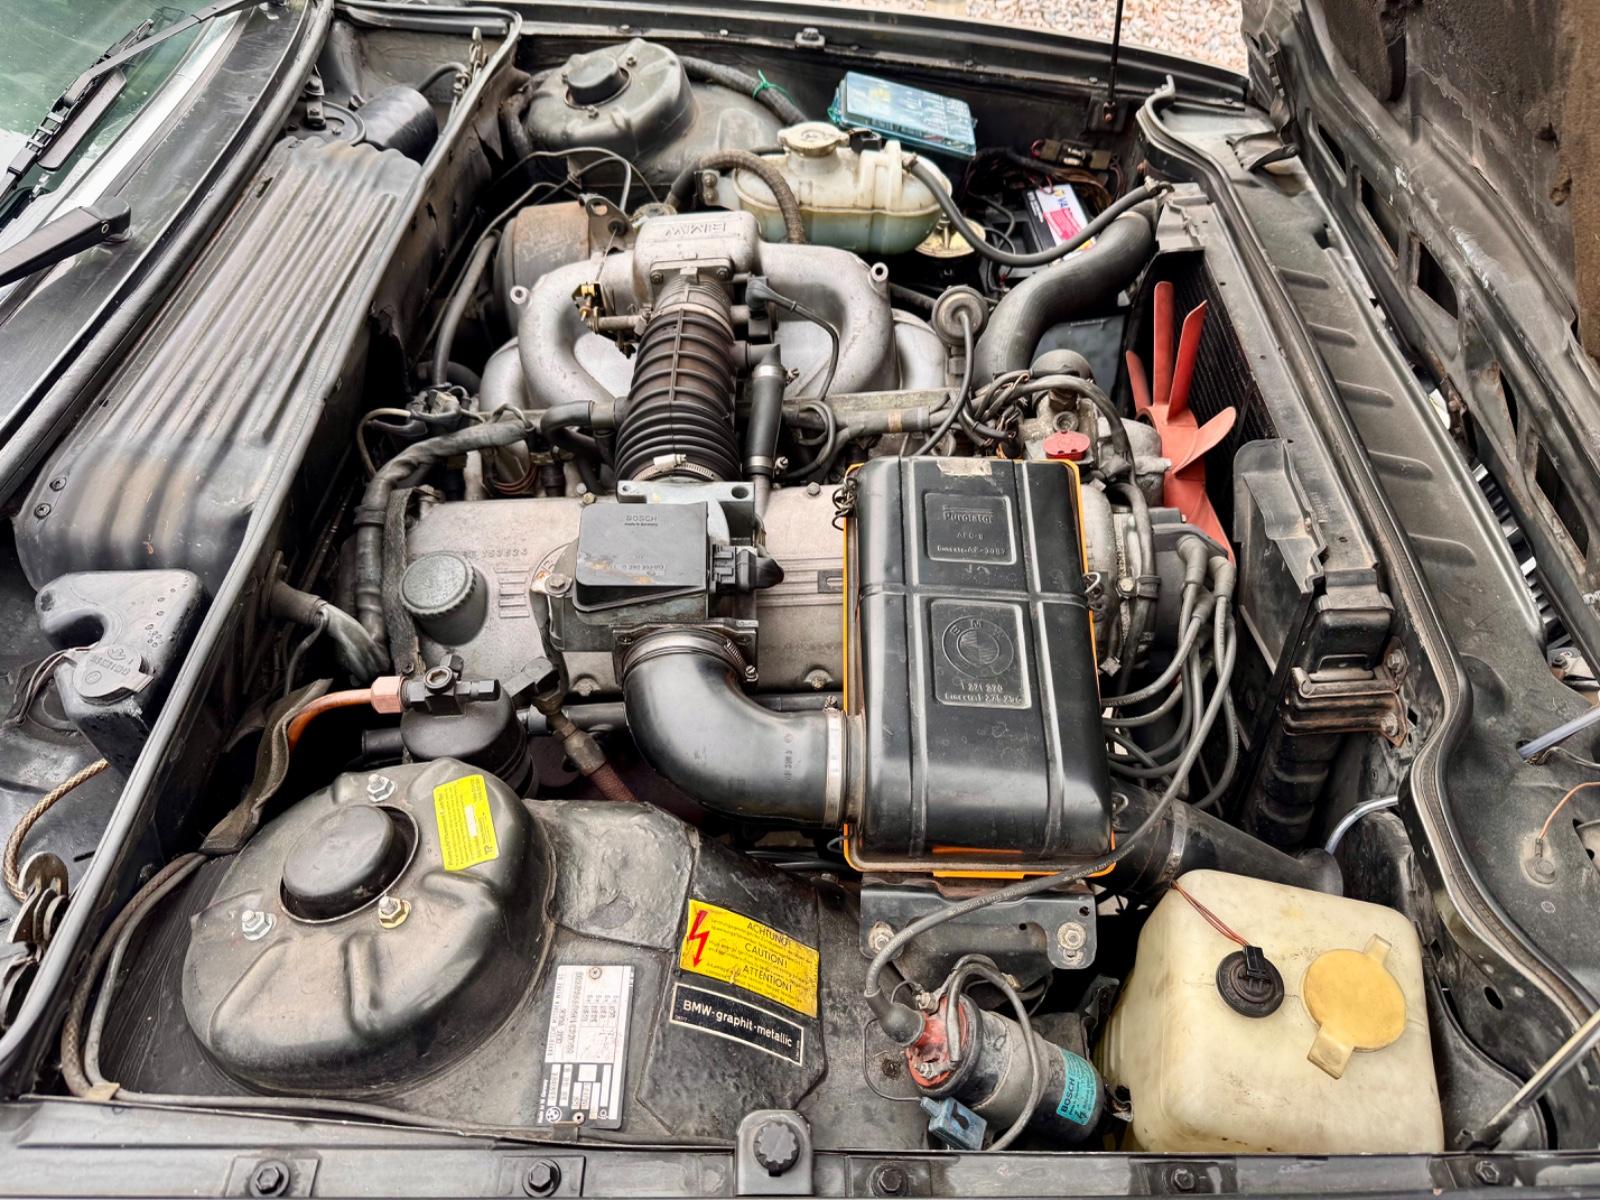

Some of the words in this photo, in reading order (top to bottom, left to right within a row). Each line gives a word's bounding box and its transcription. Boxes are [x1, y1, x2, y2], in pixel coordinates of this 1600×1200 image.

[625, 514, 657, 523] BOSCH
[744, 942, 788, 969] CAUTION!
[742, 965, 793, 993] ATTENTION!
[1060, 1077, 1075, 1112] BOSCH
